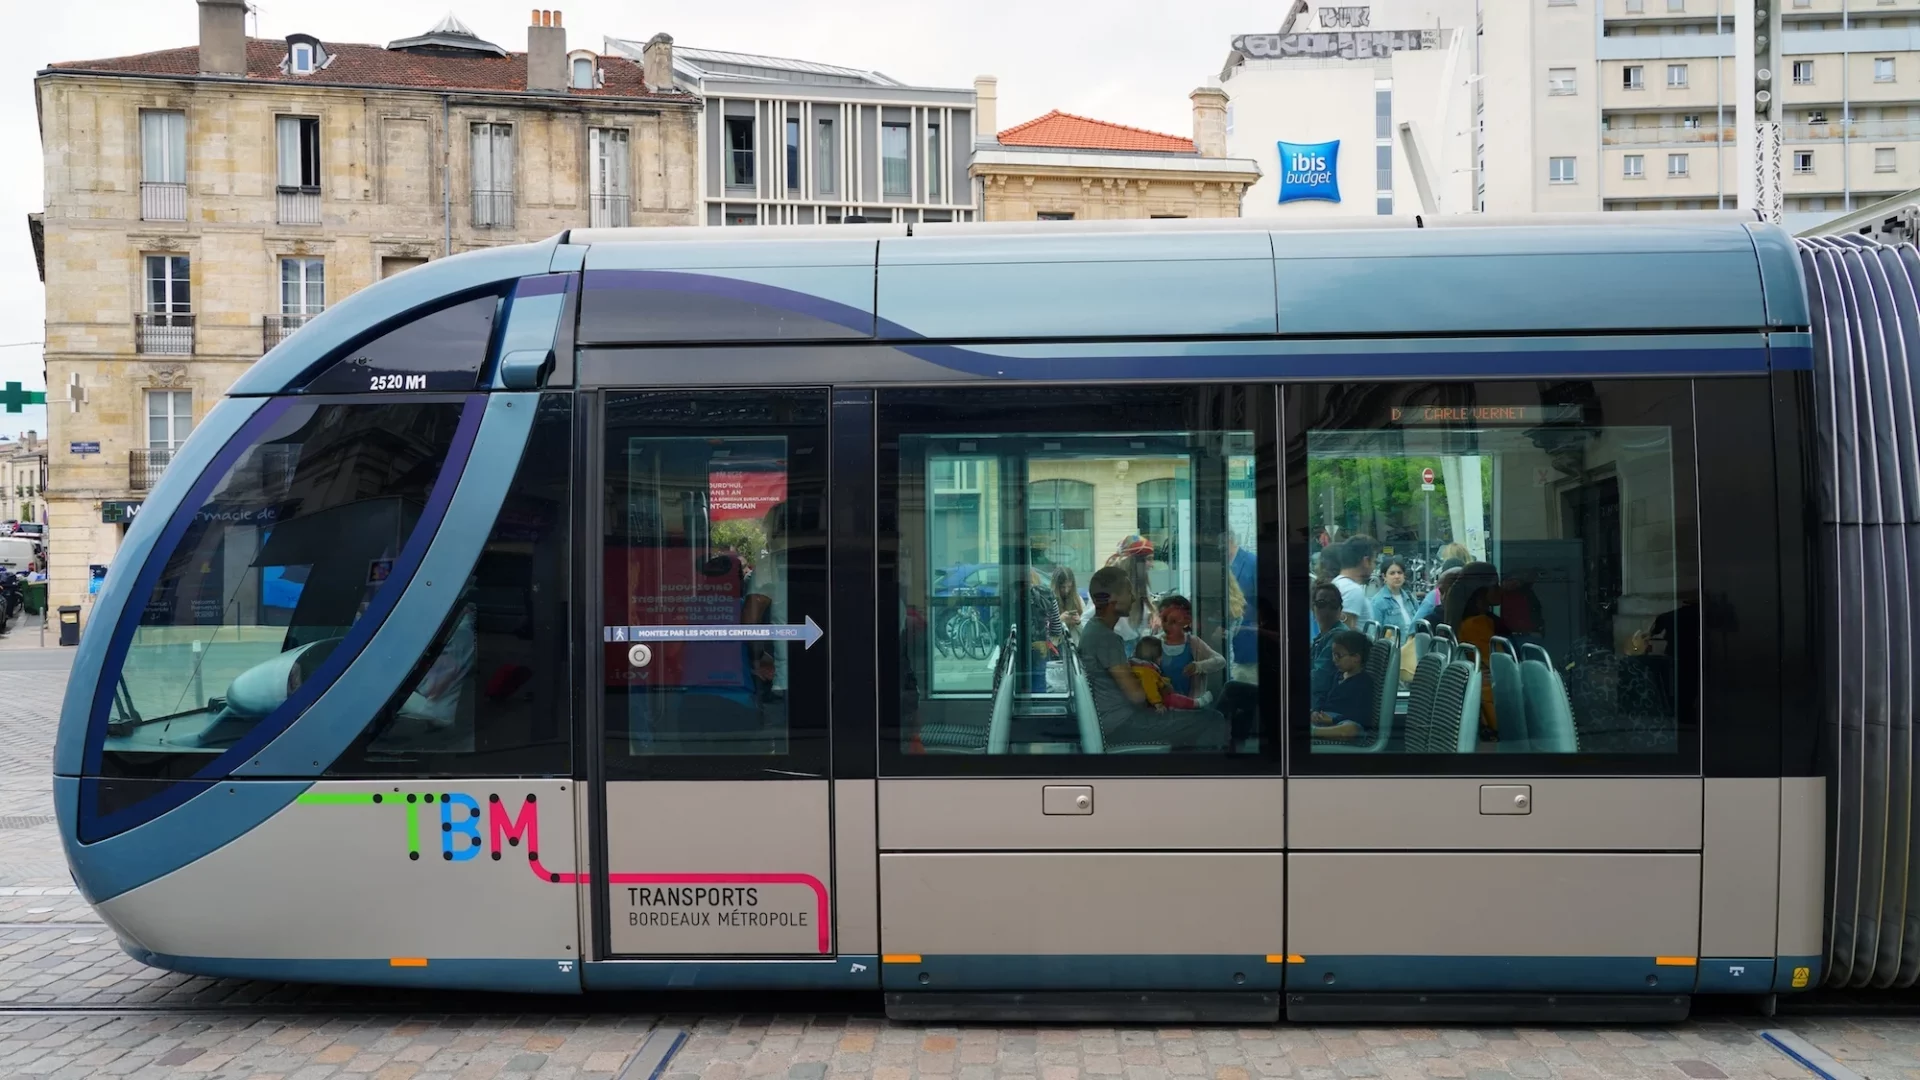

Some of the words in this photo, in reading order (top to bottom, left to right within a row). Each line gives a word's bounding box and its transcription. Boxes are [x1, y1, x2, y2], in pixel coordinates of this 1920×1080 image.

[1292, 152, 1326, 171] ibis
[1286, 170, 1332, 187] budget
[370, 374, 403, 390] 2520
[405, 374, 426, 390] M1
[1391, 409, 1401, 421] D
[1424, 407, 1468, 420] CARLE
[1473, 407, 1525, 420] VERNET
[195, 508, 252, 521] rmacie
[257, 507, 276, 520] de
[638, 629, 669, 637] MONTEZ
[670, 629, 684, 637] PAR
[685, 629, 698, 637] LES
[700, 629, 728, 637] PORTES
[729, 629, 770, 637] CENTRALES
[373, 792, 541, 862] TBM
[628, 888, 758, 907] TRANSPORTS
[629, 912, 711, 927] BORDEAUX
[718, 909, 808, 927] MÉTROPOLE
